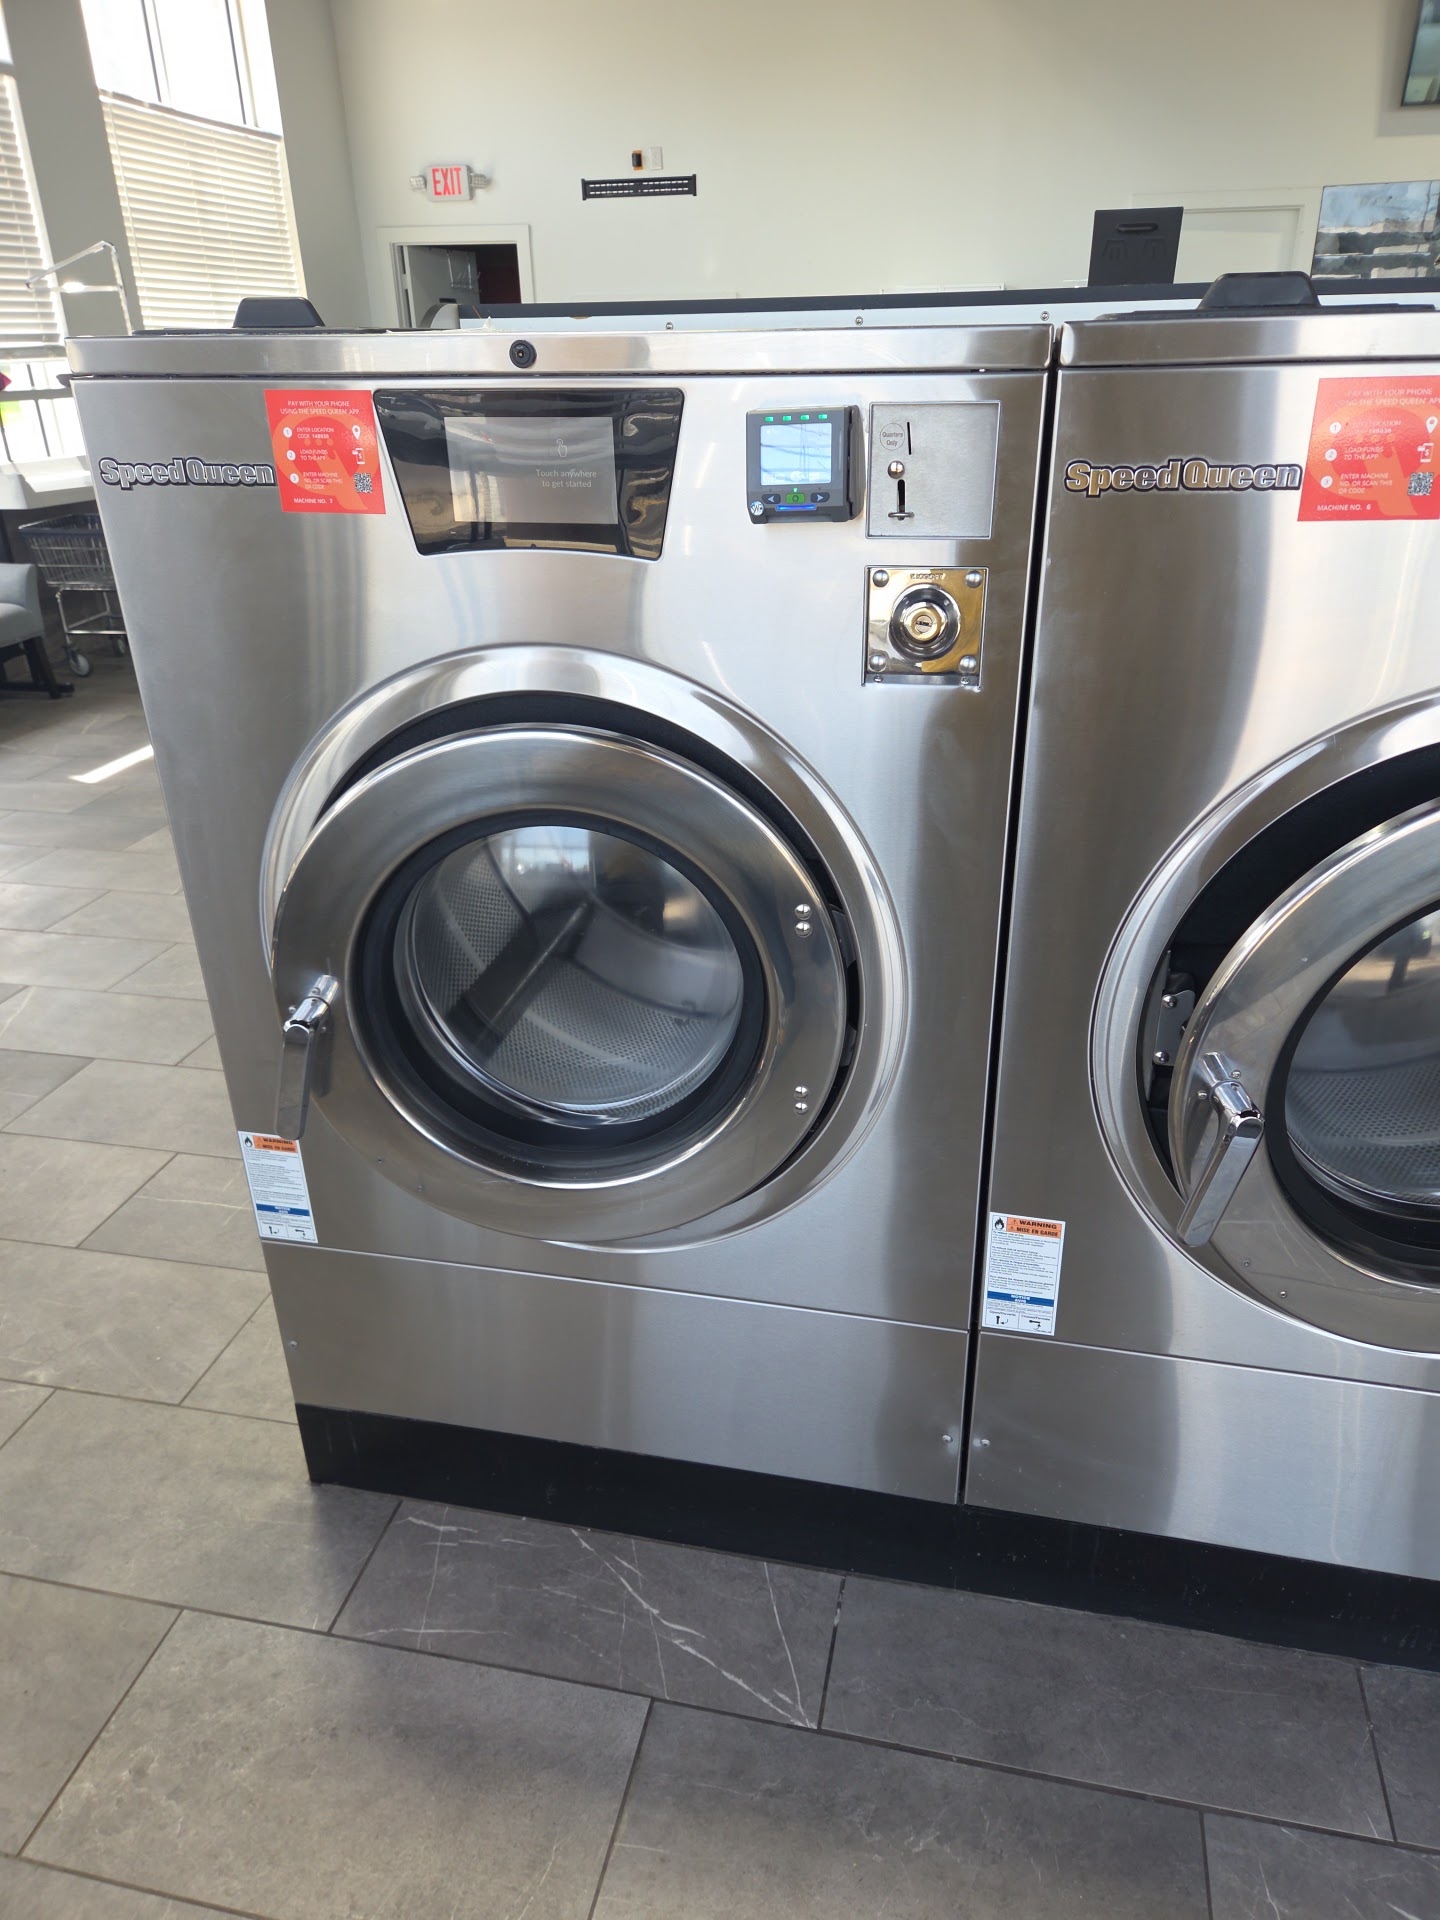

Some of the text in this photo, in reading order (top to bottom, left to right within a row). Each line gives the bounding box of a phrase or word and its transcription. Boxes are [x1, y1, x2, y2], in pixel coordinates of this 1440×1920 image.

[432, 168, 462, 195] EXIT
[1363, 389, 1383, 397] WITH
[1384, 388, 1405, 396] YOUR
[1406, 388, 1433, 396] PHONE
[1375, 398, 1398, 406] SPEED
[99, 457, 278, 490] Speed Queen
[536, 469, 597, 480] Touch anywhere
[1065, 457, 1303, 498] Speed Queen
[1340, 472, 1388, 480] ENTER MACHINE
[542, 480, 592, 489] to get started
[1317, 504, 1348, 512] MACHINE
[263, 1137, 293, 1145] WARNING
[1019, 1220, 1057, 1230] WARNING
[1016, 1226, 1030, 1234] MISE
